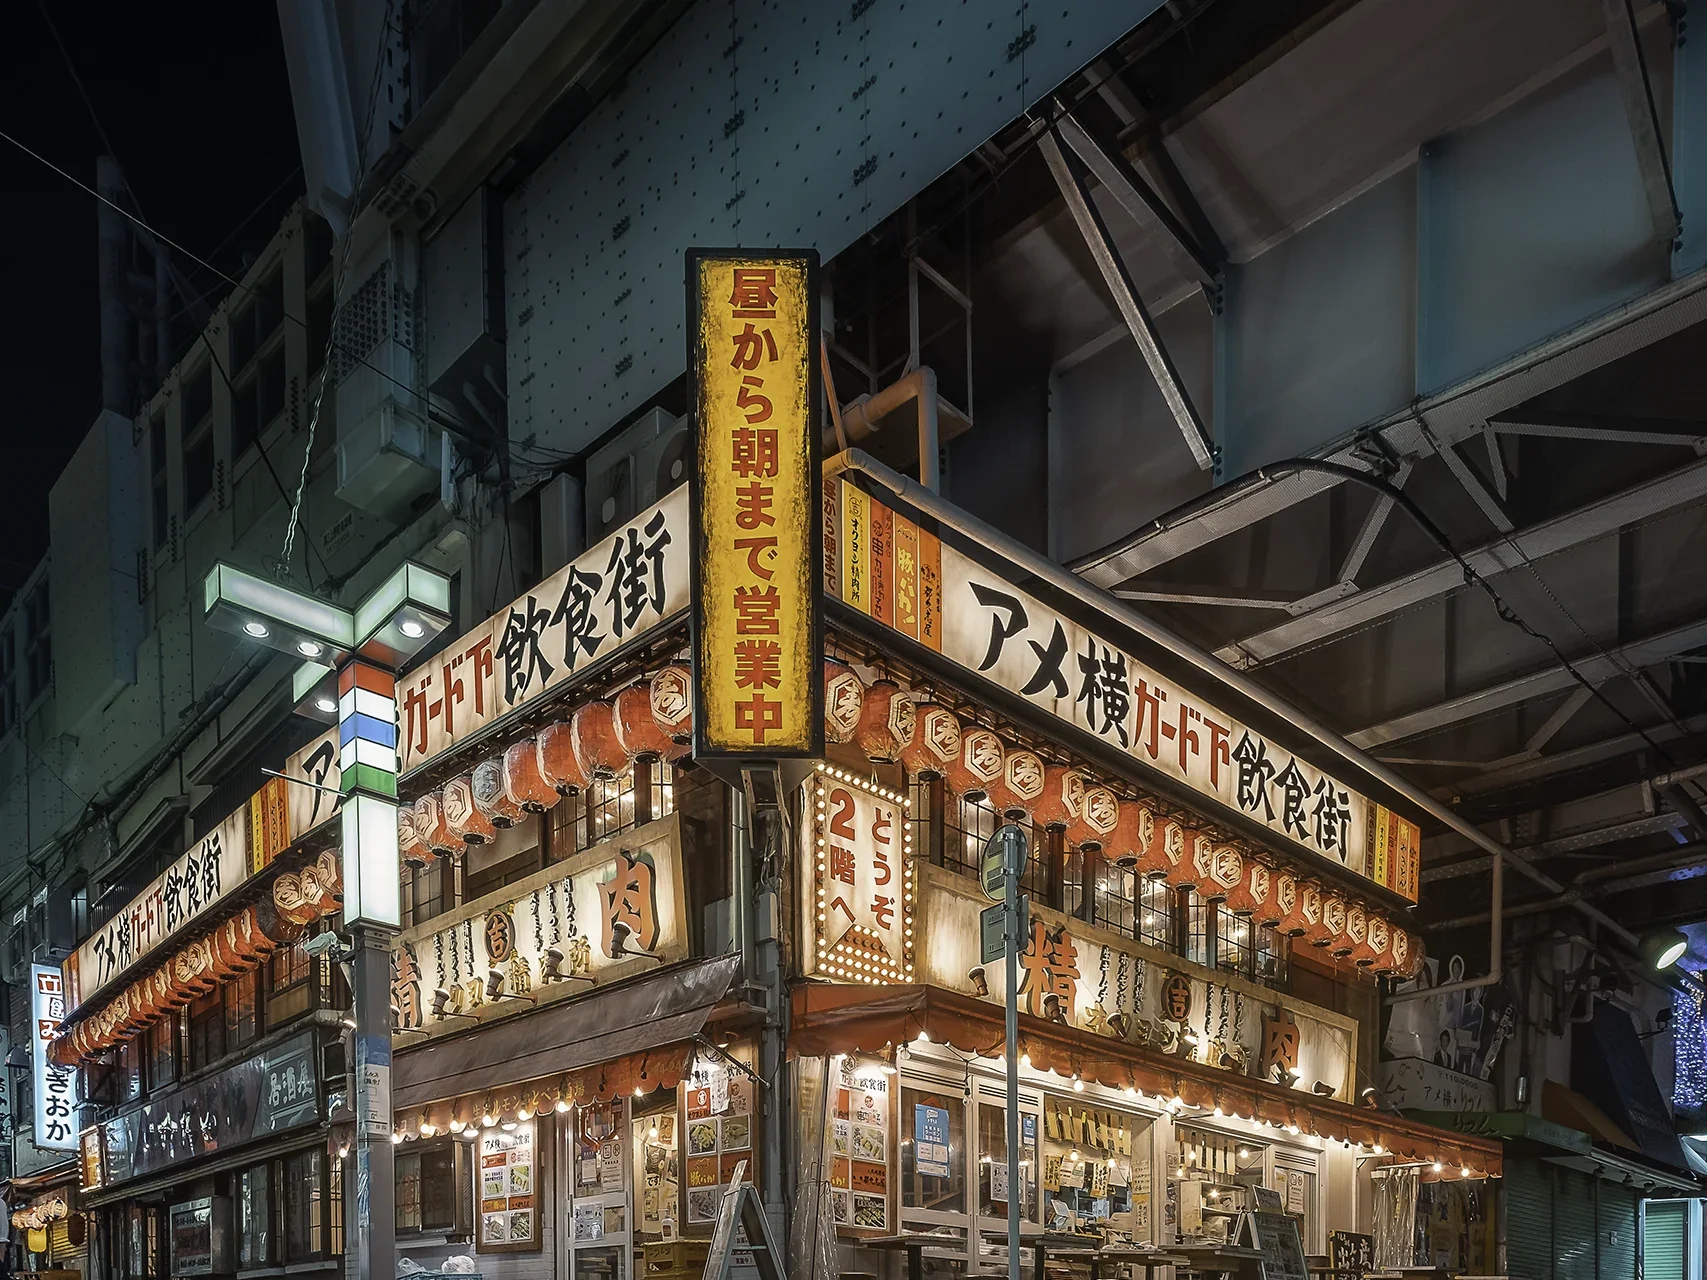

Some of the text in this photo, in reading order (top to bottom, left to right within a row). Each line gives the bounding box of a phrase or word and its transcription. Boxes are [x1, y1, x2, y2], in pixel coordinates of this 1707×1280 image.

[729, 267, 784, 745] 昼から朝まで営業中
[851, 518, 860, 602] オクヨシ精肉所
[969, 580, 1352, 864] アメ横ガード下飲食街
[597, 853, 651, 958] 肉
[829, 788, 857, 921] 2階へ
[871, 802, 893, 932] どうぞ
[94, 832, 222, 989] アメ横ガード下飲食街
[1021, 921, 1081, 1026] 精
[268, 1060, 313, 1106] 居酒屋
[1264, 1008, 1300, 1079] 肉
[46, 1064, 71, 1141] きおか
